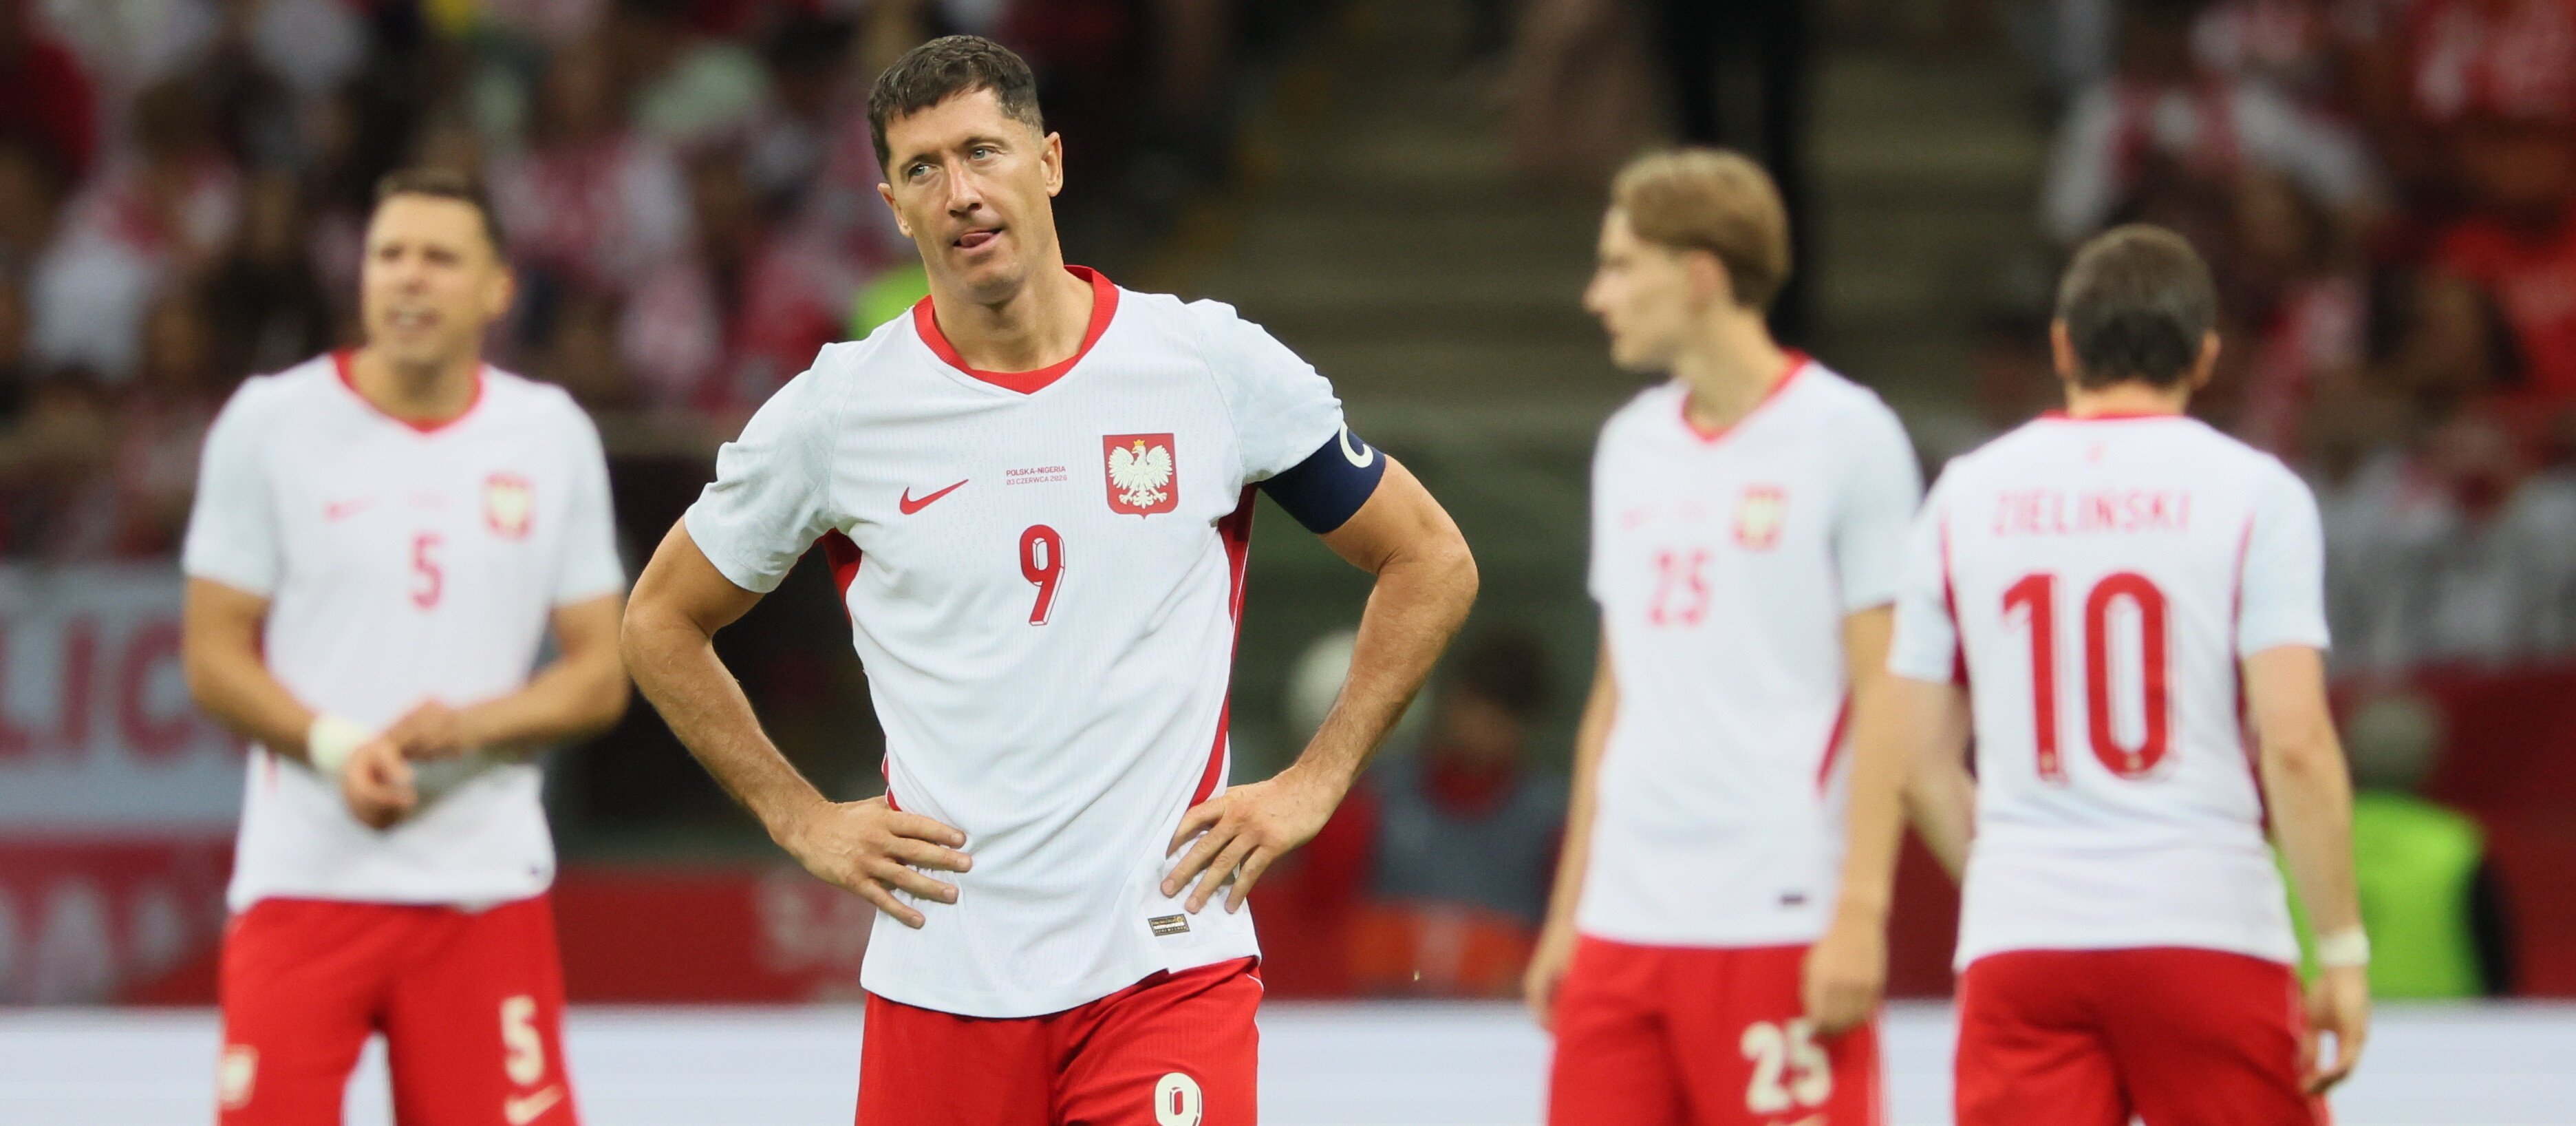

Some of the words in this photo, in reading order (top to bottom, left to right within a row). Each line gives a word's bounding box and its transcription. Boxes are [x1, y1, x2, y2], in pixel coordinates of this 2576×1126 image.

[1006, 466, 1066, 476] POLSKA-NIGERIA
[1016, 476, 1049, 485] CZERWCA
[411, 531, 444, 610] 5
[1020, 524, 1065, 626] 9
[1649, 550, 1711, 626] 25
[2001, 571, 2176, 783] 10
[500, 995, 545, 1085] 5
[1740, 1018, 1834, 1113] 25
